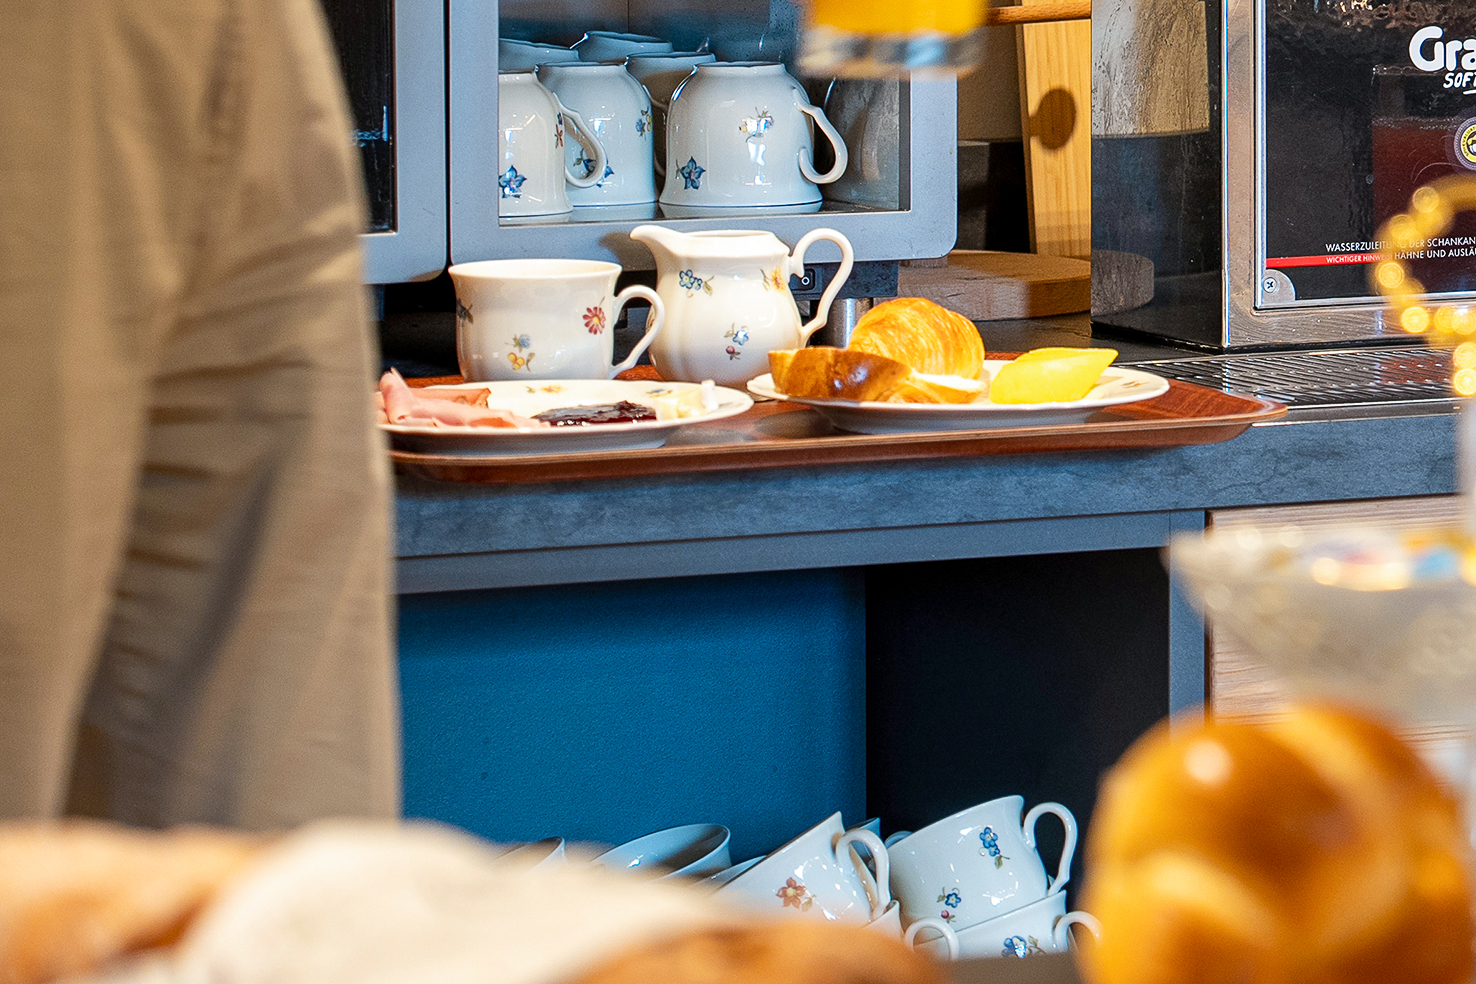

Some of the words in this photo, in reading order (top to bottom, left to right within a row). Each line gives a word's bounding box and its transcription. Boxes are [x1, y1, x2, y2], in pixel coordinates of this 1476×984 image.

[1325, 239, 1407, 252] WASSERZULEITUG
[1325, 255, 1362, 263] WICHTIGER
[1426, 249, 1447, 259] UND
